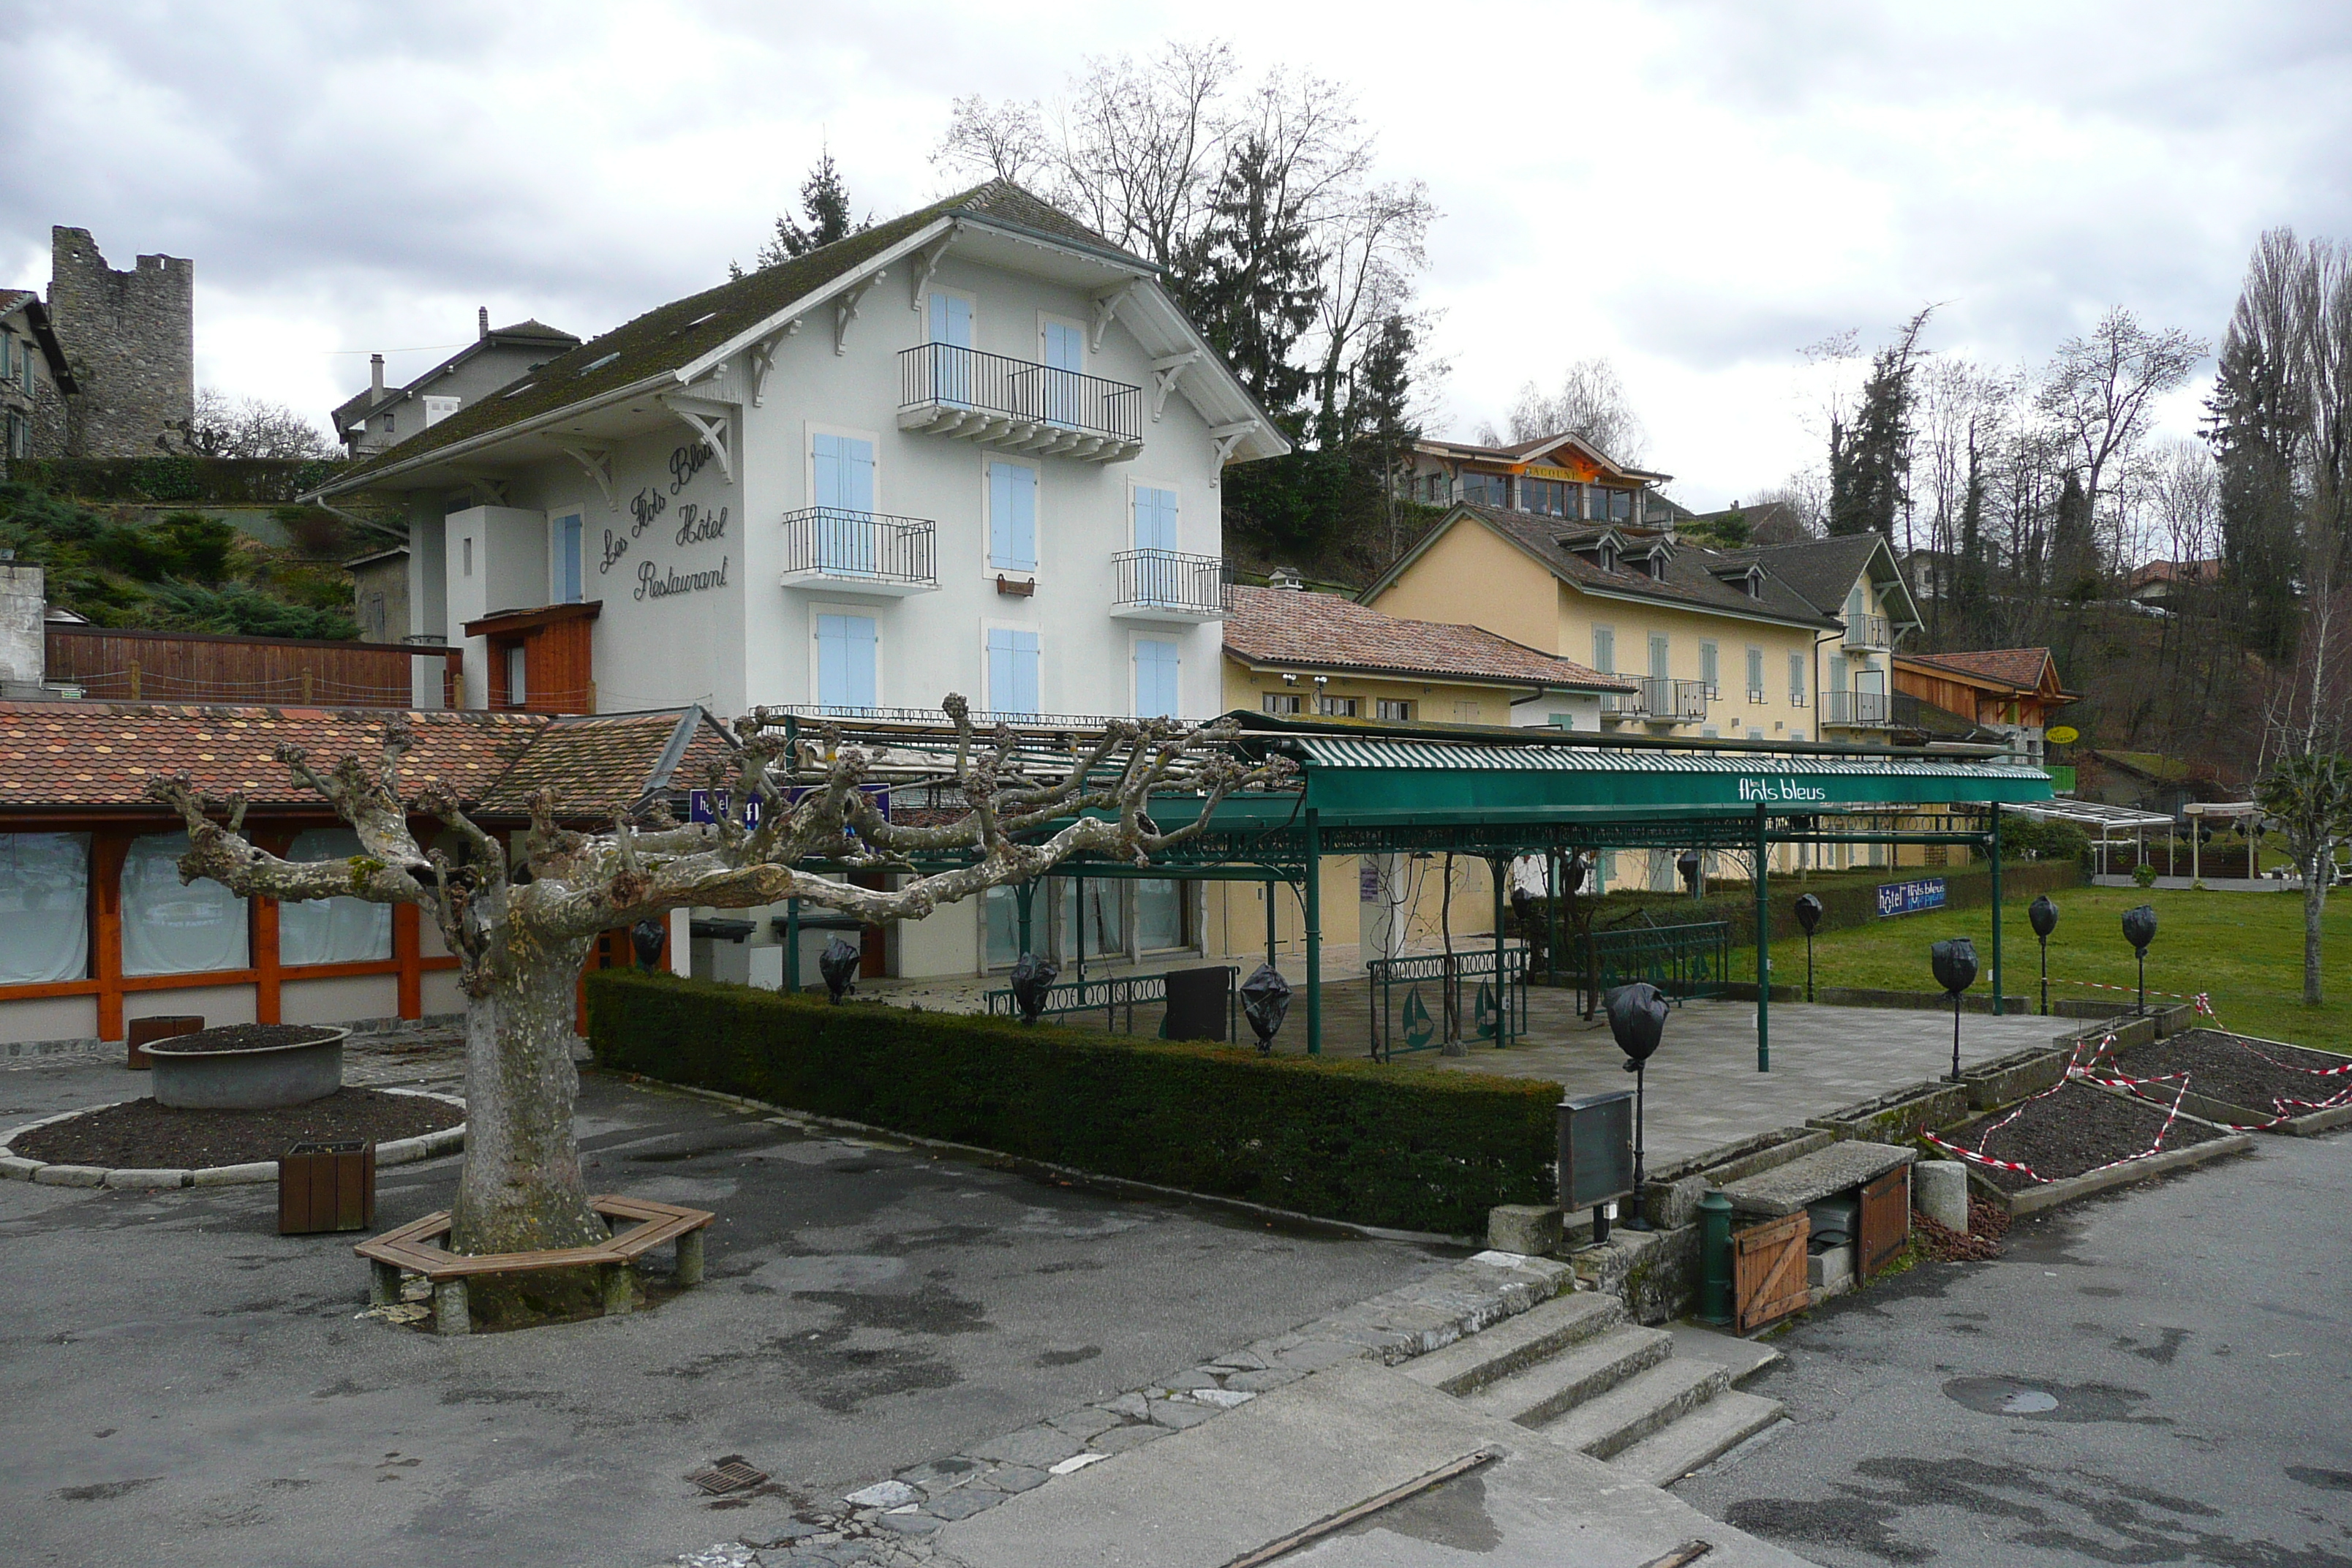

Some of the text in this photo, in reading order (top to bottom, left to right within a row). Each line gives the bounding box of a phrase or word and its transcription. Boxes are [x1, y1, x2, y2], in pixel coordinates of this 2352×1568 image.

[600, 444, 715, 574] Les Flots Bleu
[676, 504, 728, 546] Hôtel
[633, 555, 728, 600] Restaurant
[700, 795, 728, 815] hel
[1779, 778, 1826, 800] bleus
[1879, 886, 1902, 913] hôtel
[1924, 881, 1945, 894] bleus
